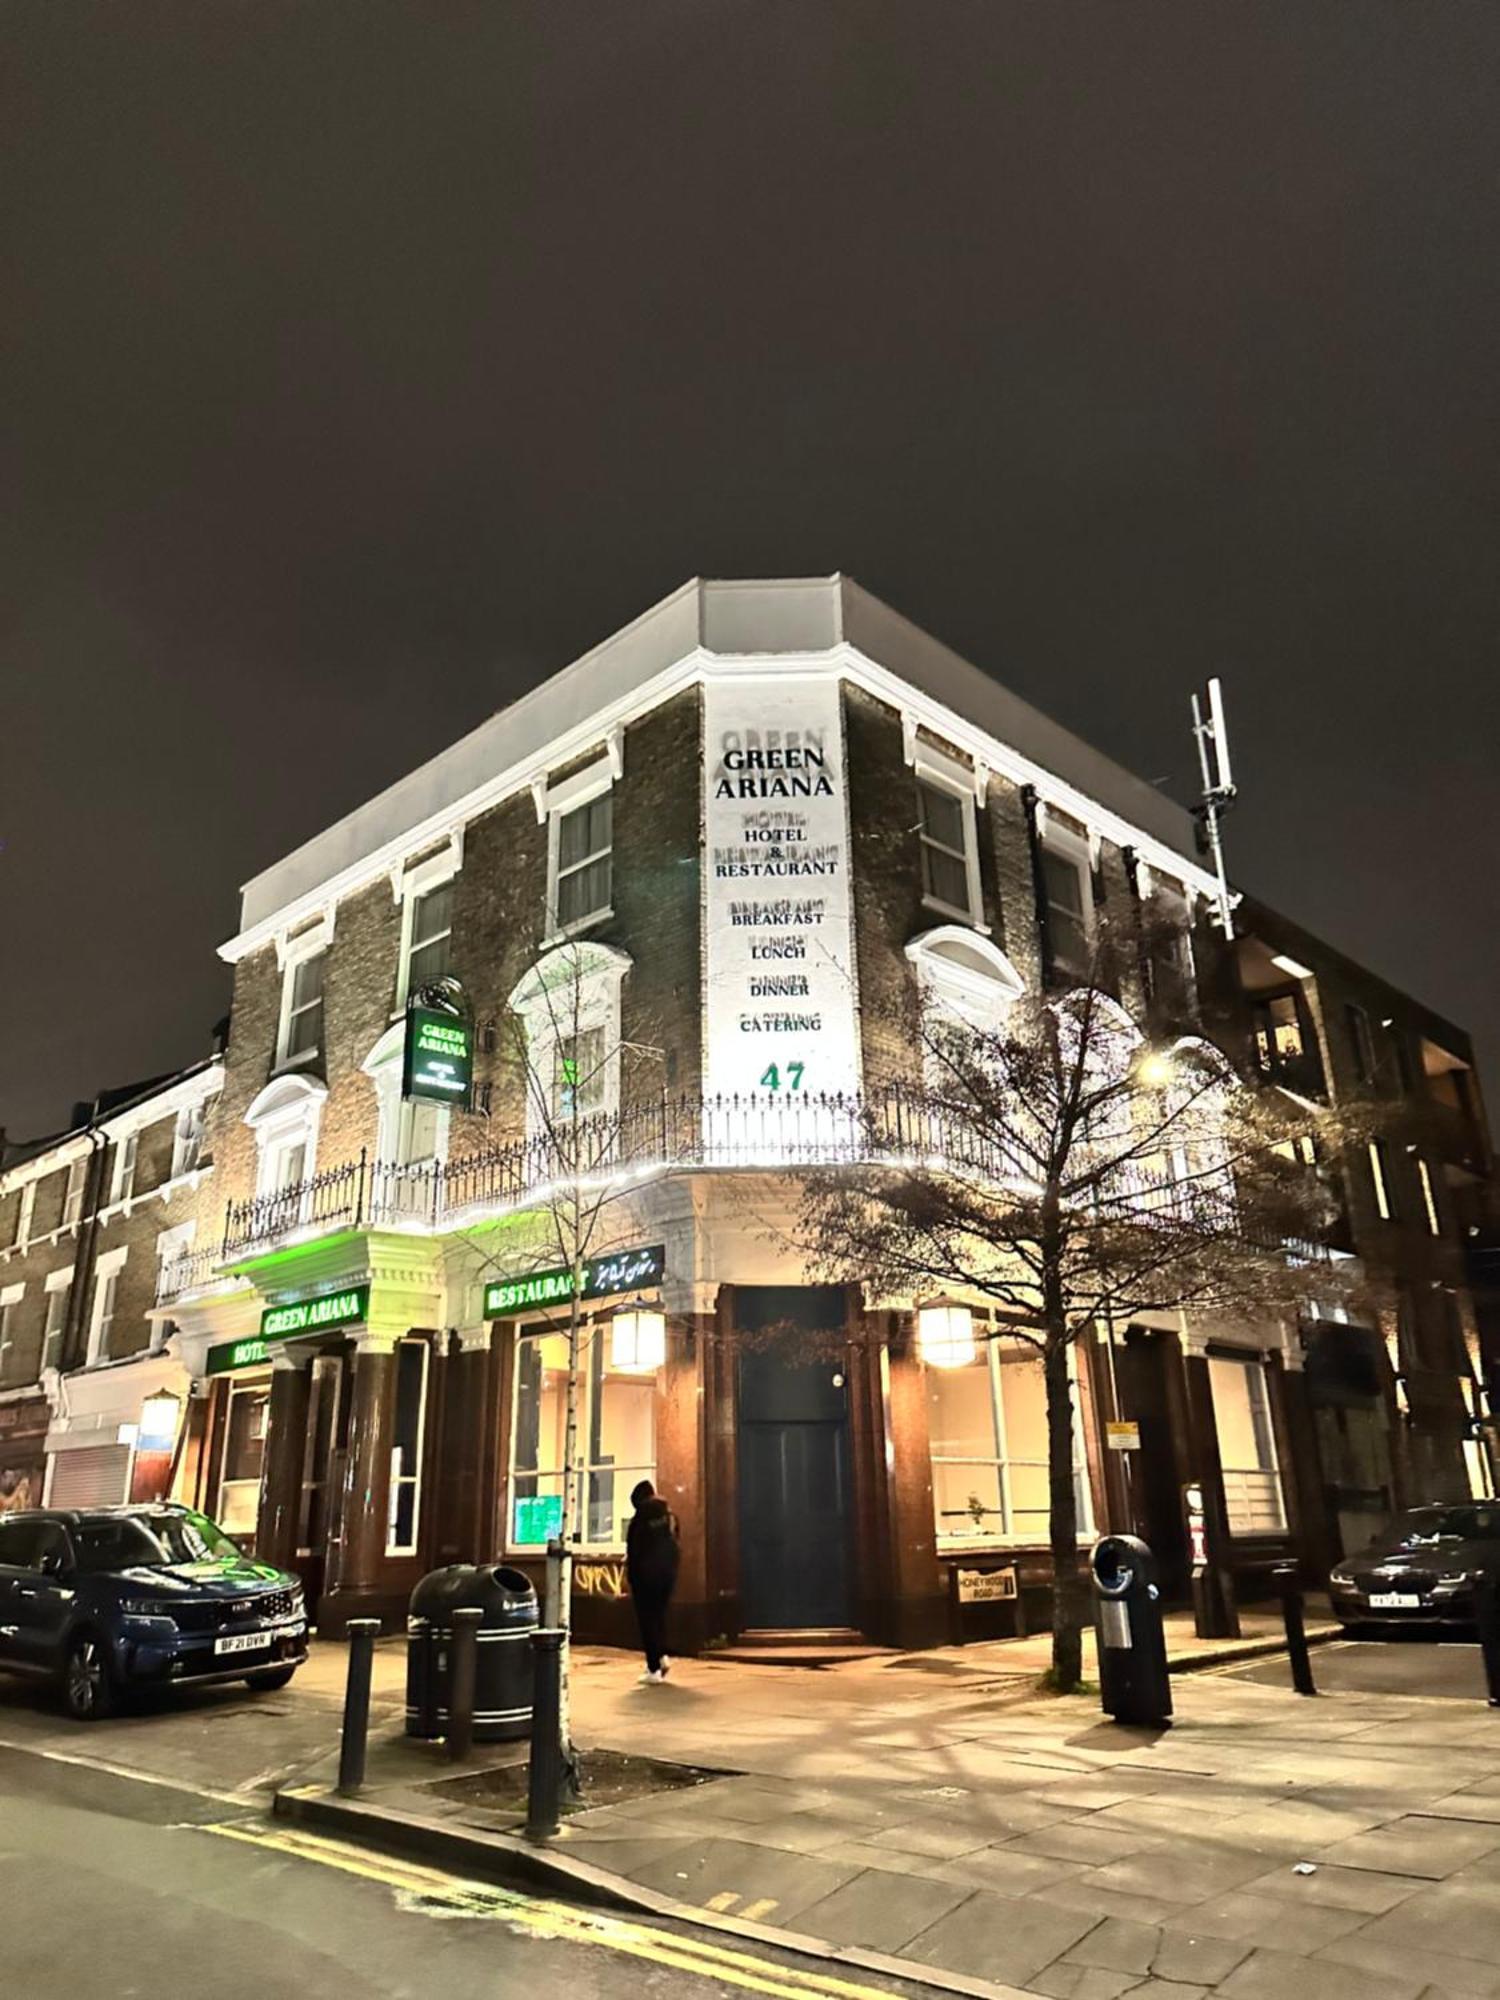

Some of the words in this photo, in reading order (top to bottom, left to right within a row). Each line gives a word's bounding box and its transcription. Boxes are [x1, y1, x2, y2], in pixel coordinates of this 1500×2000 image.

[723, 748, 824, 770] GREEN
[715, 776, 834, 799] ARIANA
[745, 829, 807, 843] HOTEL
[770, 846, 783, 858] &
[716, 862, 838, 878] RESTAURANT
[732, 914, 824, 926] BREAKFAST
[752, 946, 806, 960] LUNCH
[750, 985, 809, 997] DINNER
[740, 1019, 821, 1032] CATERING
[422, 1024, 466, 1044] GREEN
[418, 1037, 467, 1058] ARIANA
[760, 1061, 805, 1091] 47
[265, 1306, 306, 1334] GREEN
[308, 1294, 359, 1325] ARIANA
